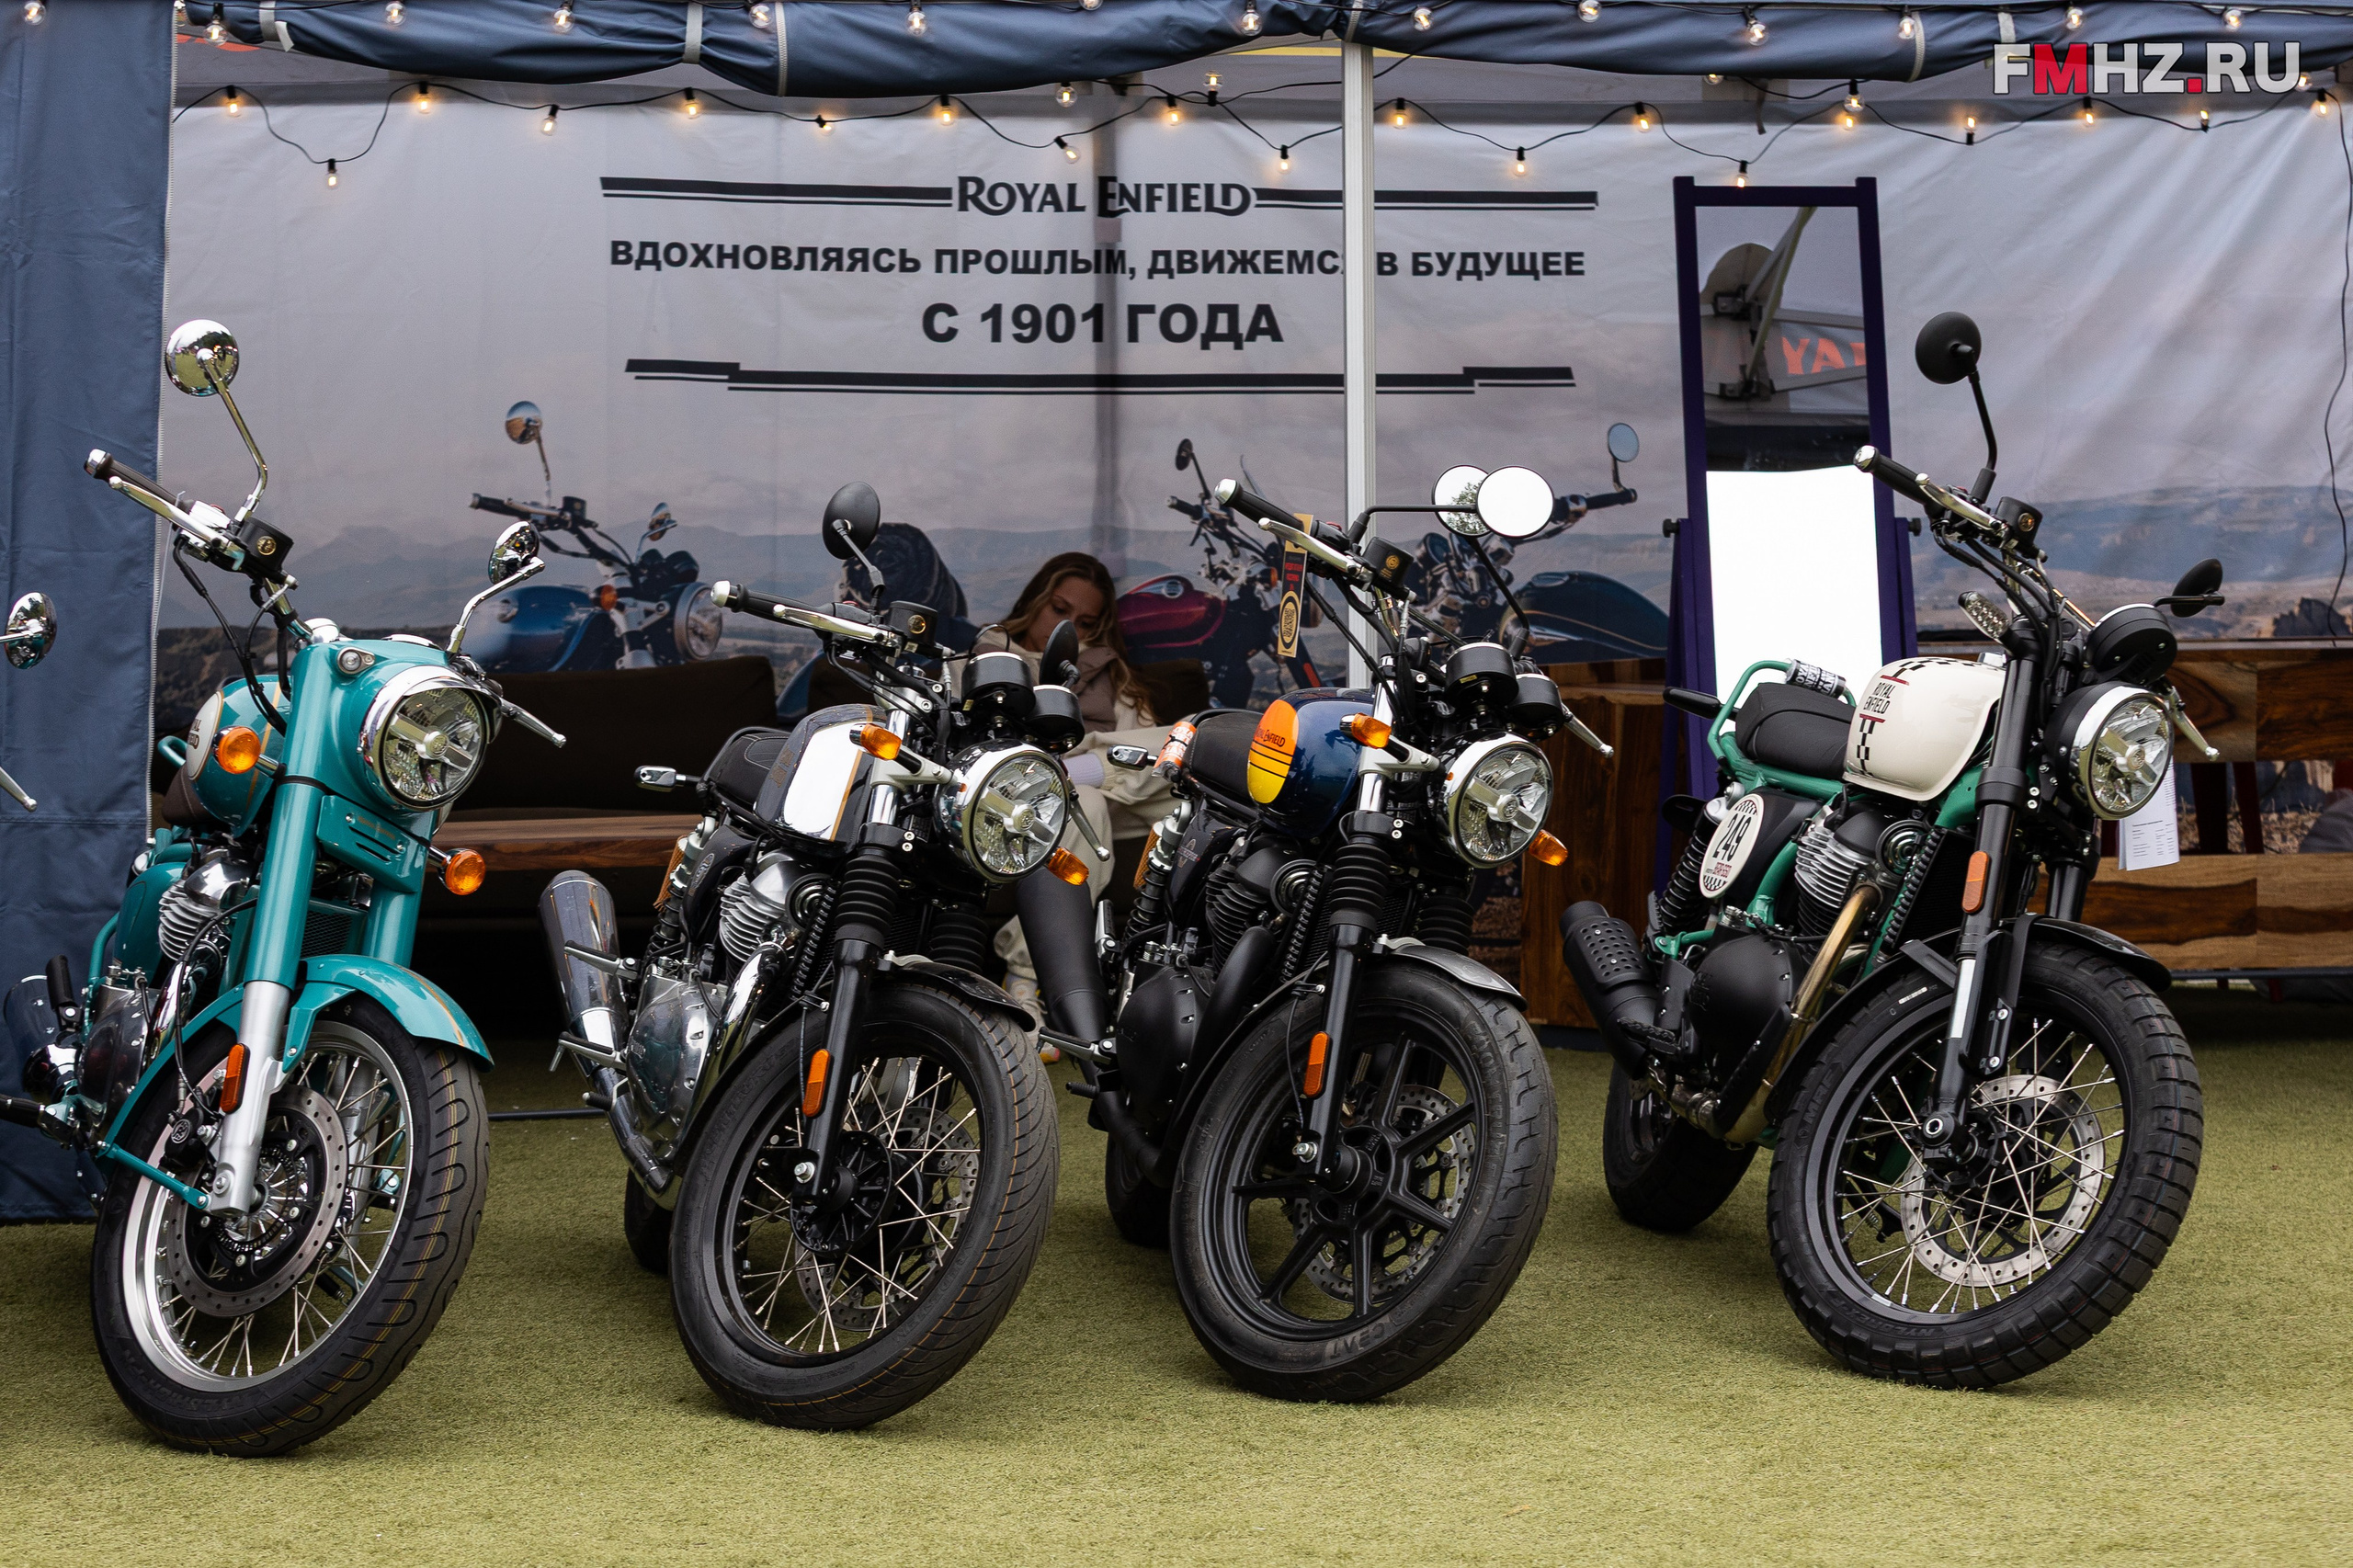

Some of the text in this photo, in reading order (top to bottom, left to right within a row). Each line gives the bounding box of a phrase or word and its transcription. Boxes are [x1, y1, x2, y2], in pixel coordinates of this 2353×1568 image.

[958, 176, 1252, 218] ROYAL ENFIELD
[611, 240, 1586, 282] ВДОХНОВЛЯЯСЬ ПРОШЛЫМ, ДВИЖЕМС В БУДУЩЕЕ
[922, 302, 1284, 350] С 1901 ГОДА
[1863, 696, 1891, 714] ENFIELD
[1872, 682, 1896, 699] ROYAL
[1712, 812, 1752, 862] 249
